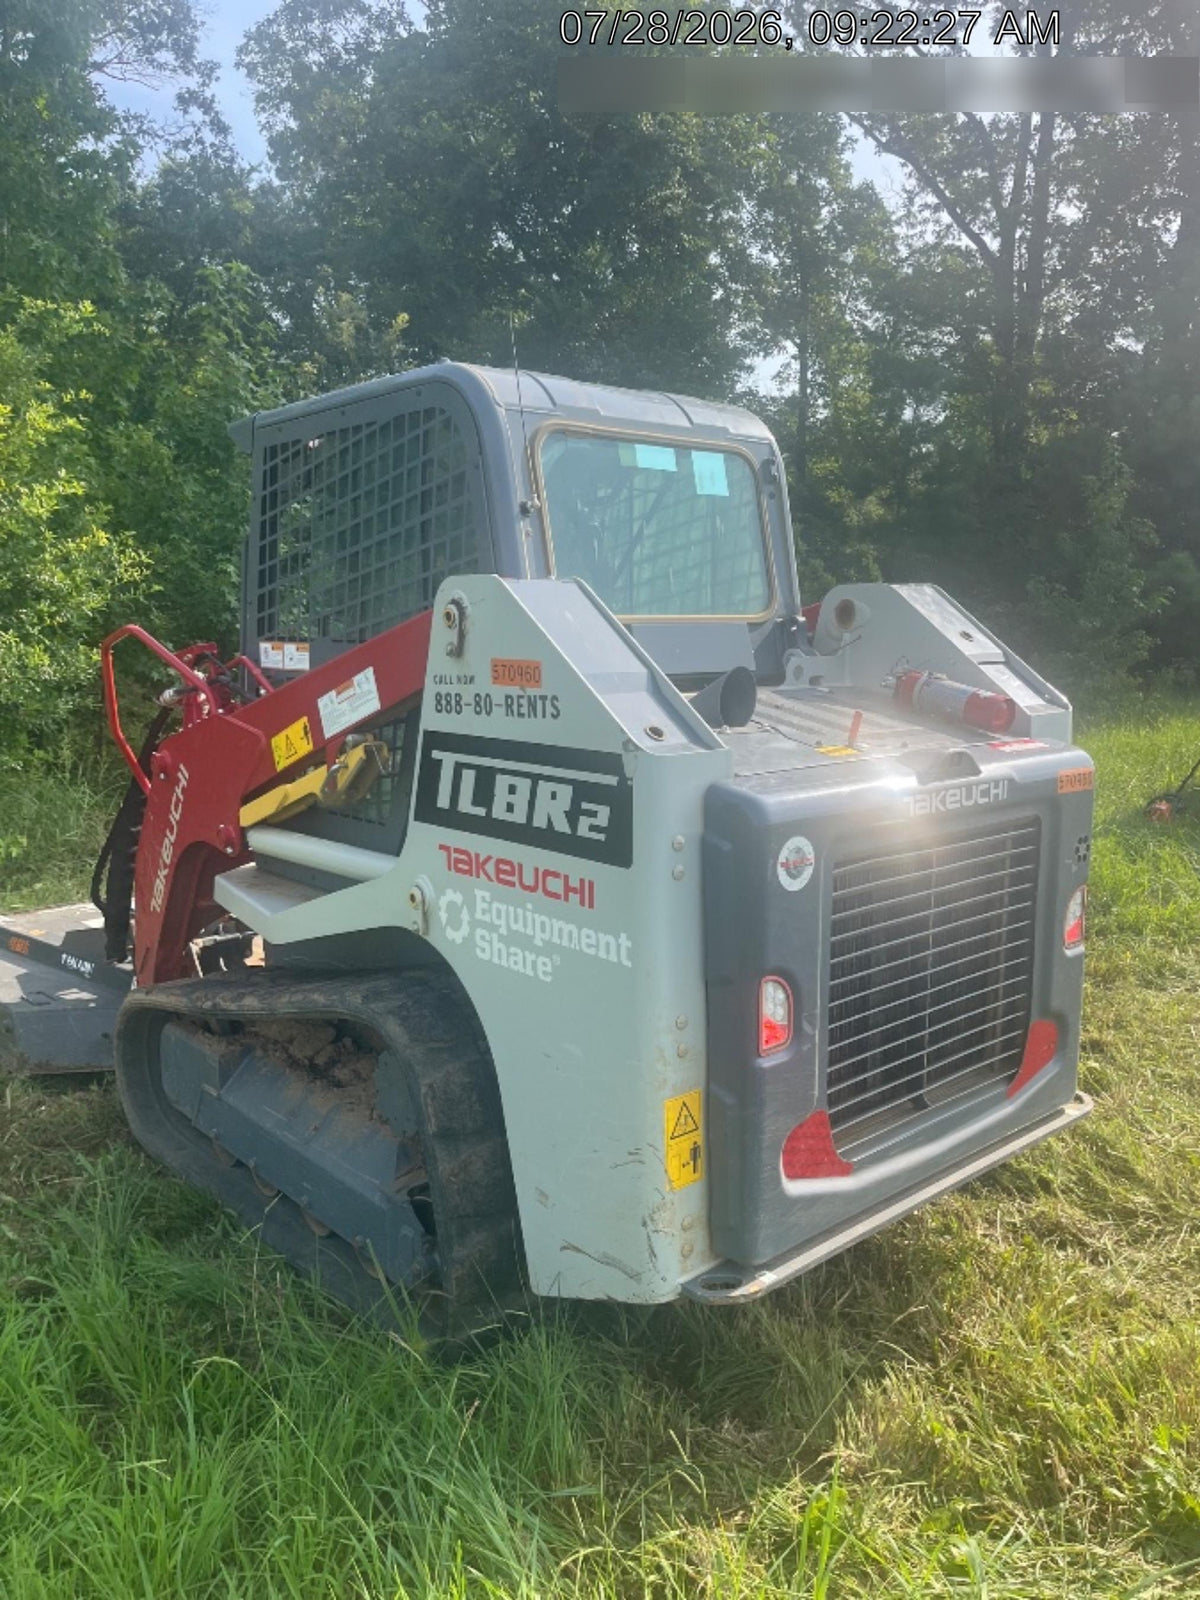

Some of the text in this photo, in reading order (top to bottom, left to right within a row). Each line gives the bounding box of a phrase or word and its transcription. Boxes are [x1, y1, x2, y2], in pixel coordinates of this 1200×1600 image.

[433, 674, 476, 686] CALL NOW
[492, 664, 541, 684] 570960
[434, 691, 561, 720] 888-80-RENTS
[903, 779, 1008, 817] TAKEUCHI
[438, 843, 595, 910] TAKEUCHI
[473, 888, 632, 968] Equipment
